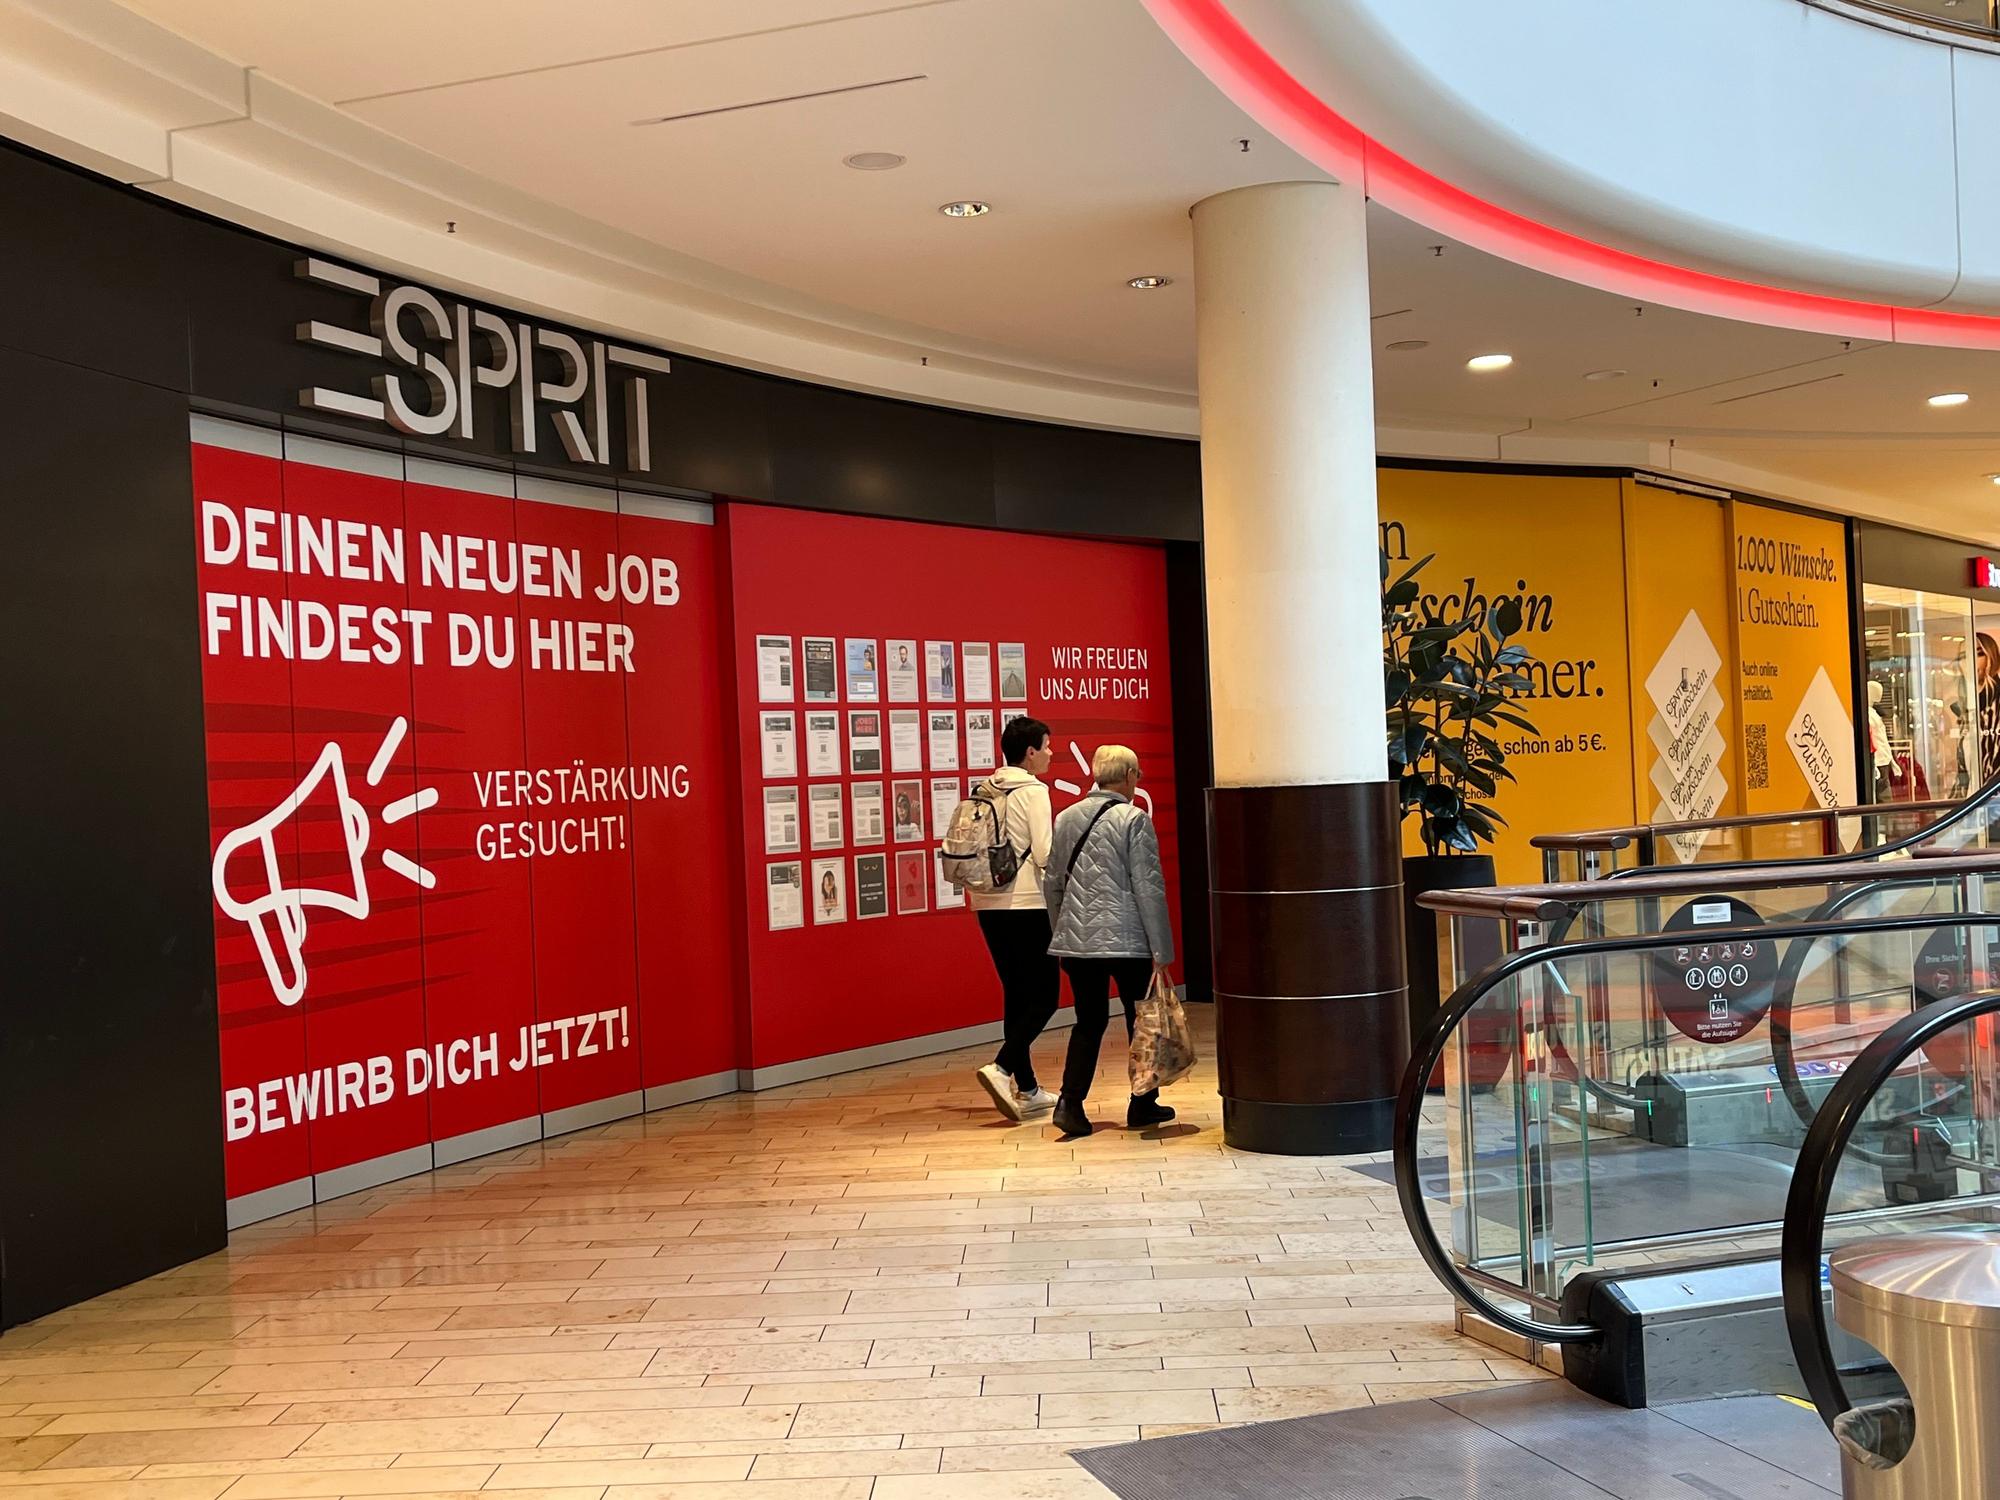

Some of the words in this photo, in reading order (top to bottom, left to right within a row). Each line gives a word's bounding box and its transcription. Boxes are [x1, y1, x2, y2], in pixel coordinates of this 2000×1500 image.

[295, 257, 671, 472] ESPRIT
[202, 500, 405, 584] DEINEN
[420, 531, 582, 599] NEUEN
[594, 553, 681, 606] JOB
[1737, 535, 1776, 574] 1.000
[1779, 542, 1837, 582] Wünsche.
[1748, 588, 1819, 628] Gutschein.
[206, 592, 432, 665] FINDEST
[448, 612, 515, 668] DU
[529, 618, 636, 673] HIER
[1051, 646, 1082, 669] WIR
[1086, 647, 1148, 669] FREUEN
[1759, 661, 1778, 677] online
[1040, 677, 1075, 700] UNS
[1078, 677, 1109, 700] AUF
[1112, 678, 1149, 699] DICH
[1504, 736, 1550, 755] schon
[1555, 734, 1574, 752] ab
[1802, 713, 1834, 772] CENTER
[473, 760, 690, 808] VERSTÄRKUNG
[476, 815, 626, 861] GESUCHT!
[1733, 1020, 1742, 1028] Sie
[225, 1055, 394, 1142] BEWIRB
[406, 1033, 499, 1096] DICH
[508, 1006, 630, 1072] JETZT!
